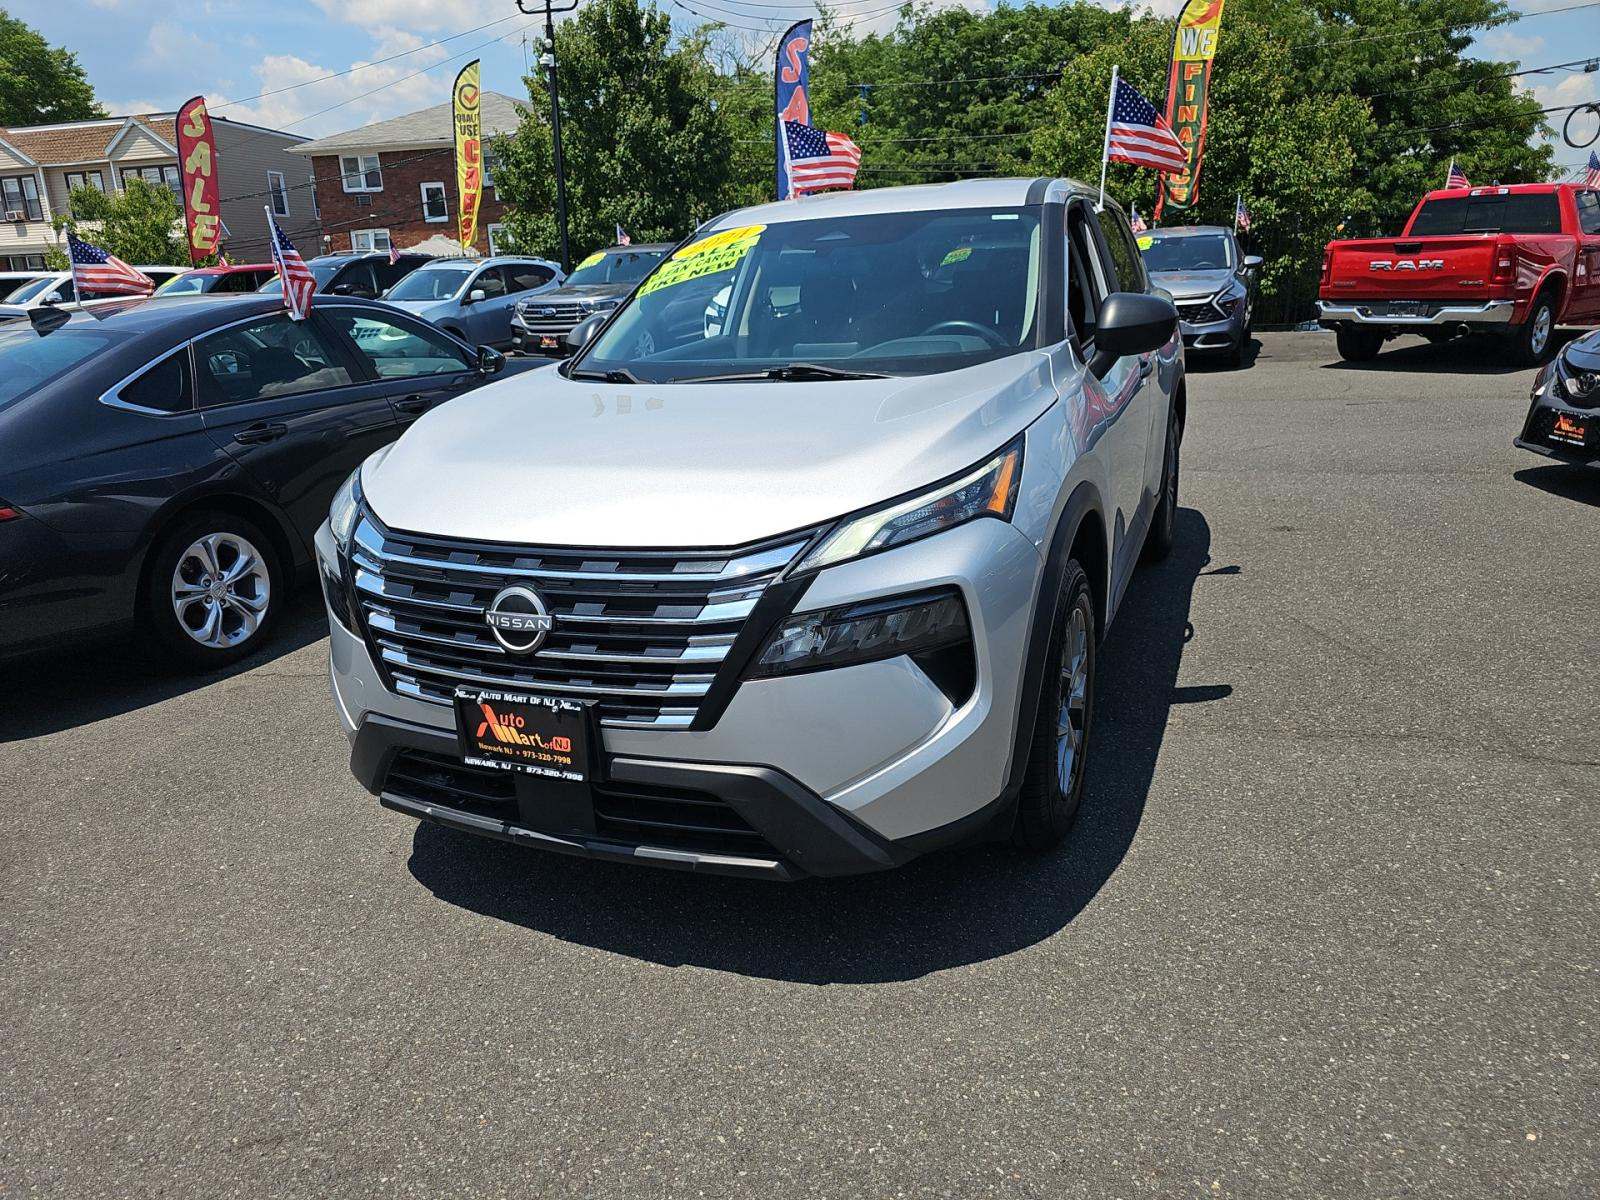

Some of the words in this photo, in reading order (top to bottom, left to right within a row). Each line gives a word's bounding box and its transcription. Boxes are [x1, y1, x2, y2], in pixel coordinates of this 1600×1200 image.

[1180, 26, 1217, 57] WE
[781, 37, 809, 126] SA
[460, 124, 478, 137] USE
[183, 104, 219, 250] SALE
[696, 249, 745, 267] CARFAX
[1369, 259, 1444, 272] RAM
[640, 274, 683, 294] LIKE
[689, 259, 736, 277] NEW
[486, 613, 550, 630] NISSAN
[543, 698, 556, 707] NJ
[522, 750, 572, 765] 973-320-7998
[501, 762, 512, 770] NJ
[526, 766, 584, 782] 973-320-7998
